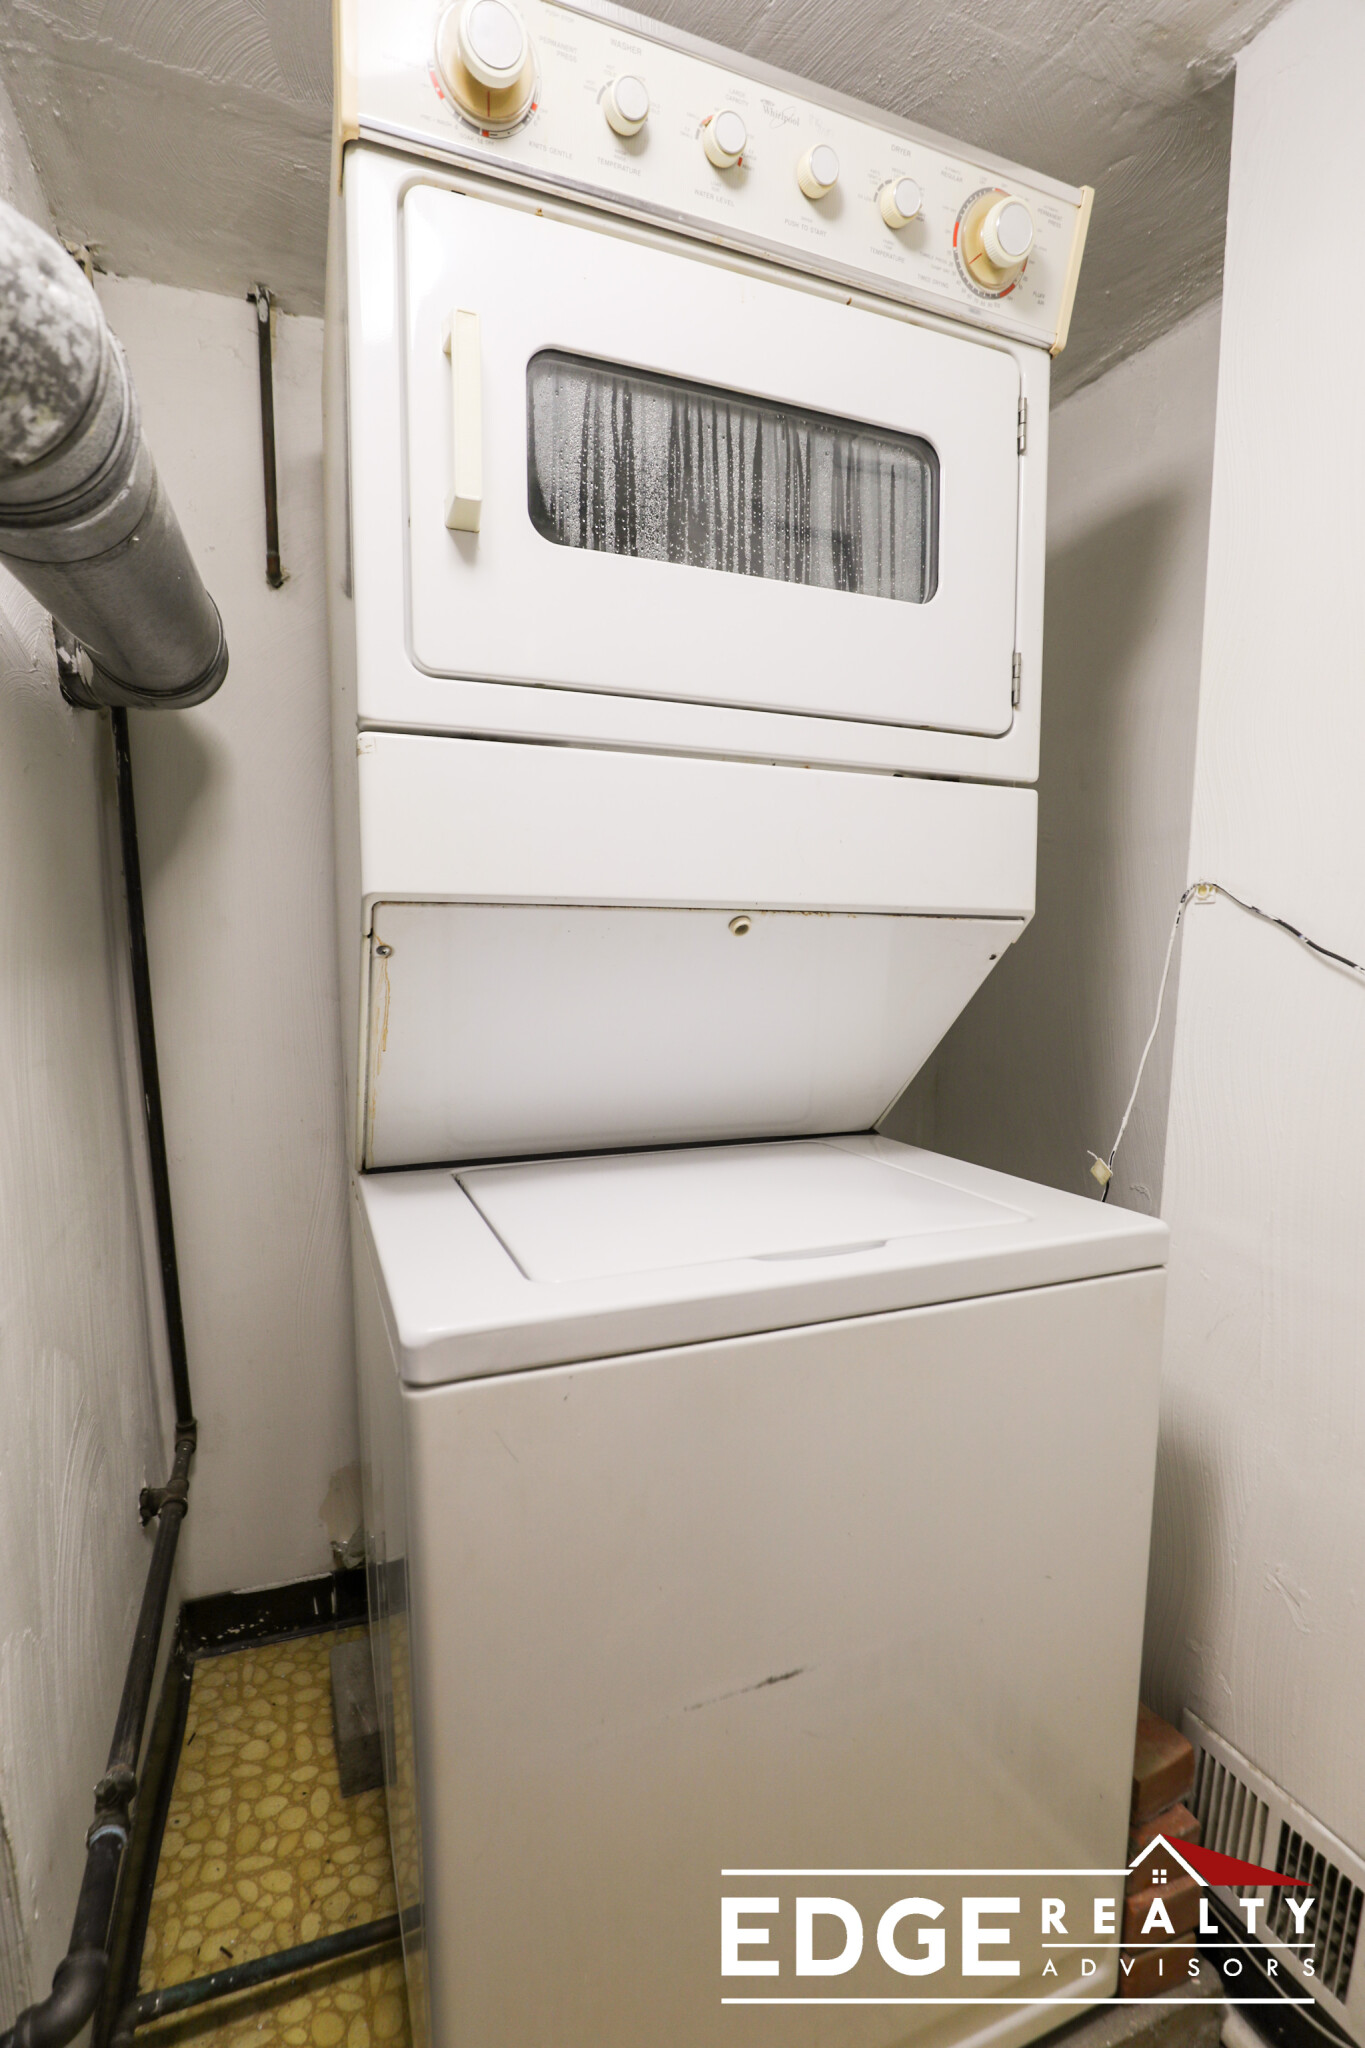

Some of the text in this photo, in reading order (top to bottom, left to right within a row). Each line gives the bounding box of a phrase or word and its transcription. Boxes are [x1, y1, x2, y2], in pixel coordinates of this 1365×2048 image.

[539, 35, 578, 54] PERMANENT
[610, 38, 642, 56] WASHER
[556, 50, 577, 63] PRESS
[763, 104, 800, 127] Whirlpool
[528, 140, 573, 160] KNITS GENTLE
[891, 144, 911, 158] DRYER
[597, 156, 642, 177] TEMPERATURE
[941, 171, 963, 183] REGULAR
[694, 189, 735, 207] WATER LEVEL
[784, 218, 799, 228] PUSH
[801, 224, 808, 232] TO
[810, 227, 827, 237] START
[870, 246, 905, 263] TEMPERATURE
